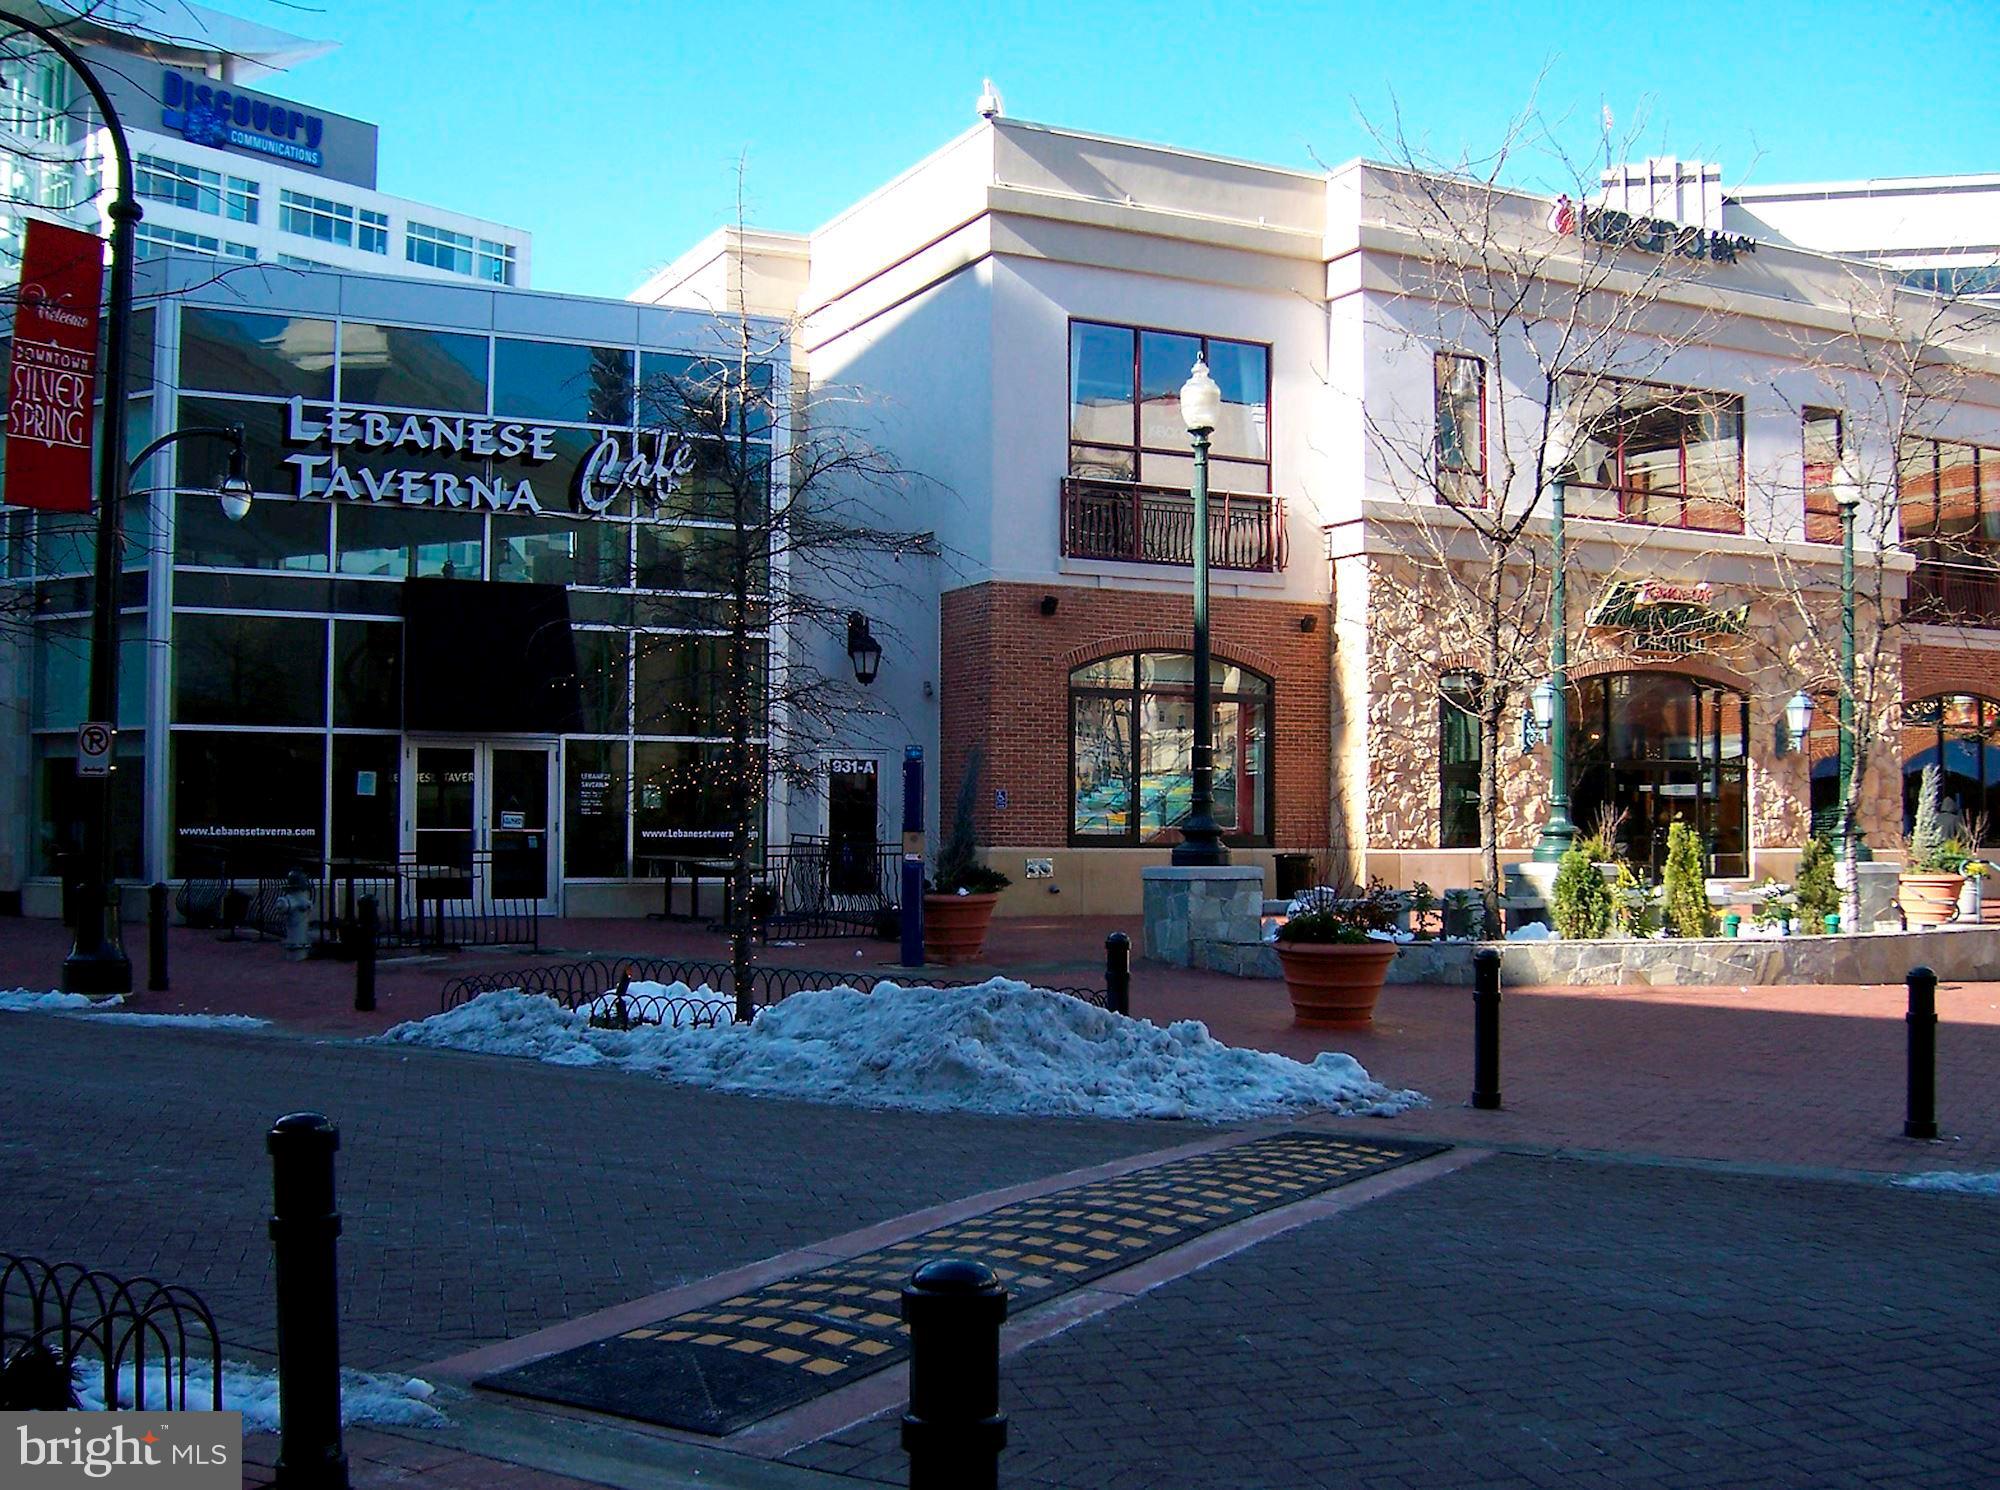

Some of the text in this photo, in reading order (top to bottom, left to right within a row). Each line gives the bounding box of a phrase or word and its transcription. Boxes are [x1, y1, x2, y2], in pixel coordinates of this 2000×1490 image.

[230, 130, 318, 165] COMMUNICATIONS
[17, 346, 89, 371] DOWNTOWN
[14, 365, 85, 410] SILVER
[11, 399, 84, 444] SPRING
[289, 395, 557, 461] LEBANESE
[284, 453, 543, 515] TAVERNA
[832, 760, 874, 774] 931-A
[179, 826, 316, 837] www.Lebanesetaverna.com
